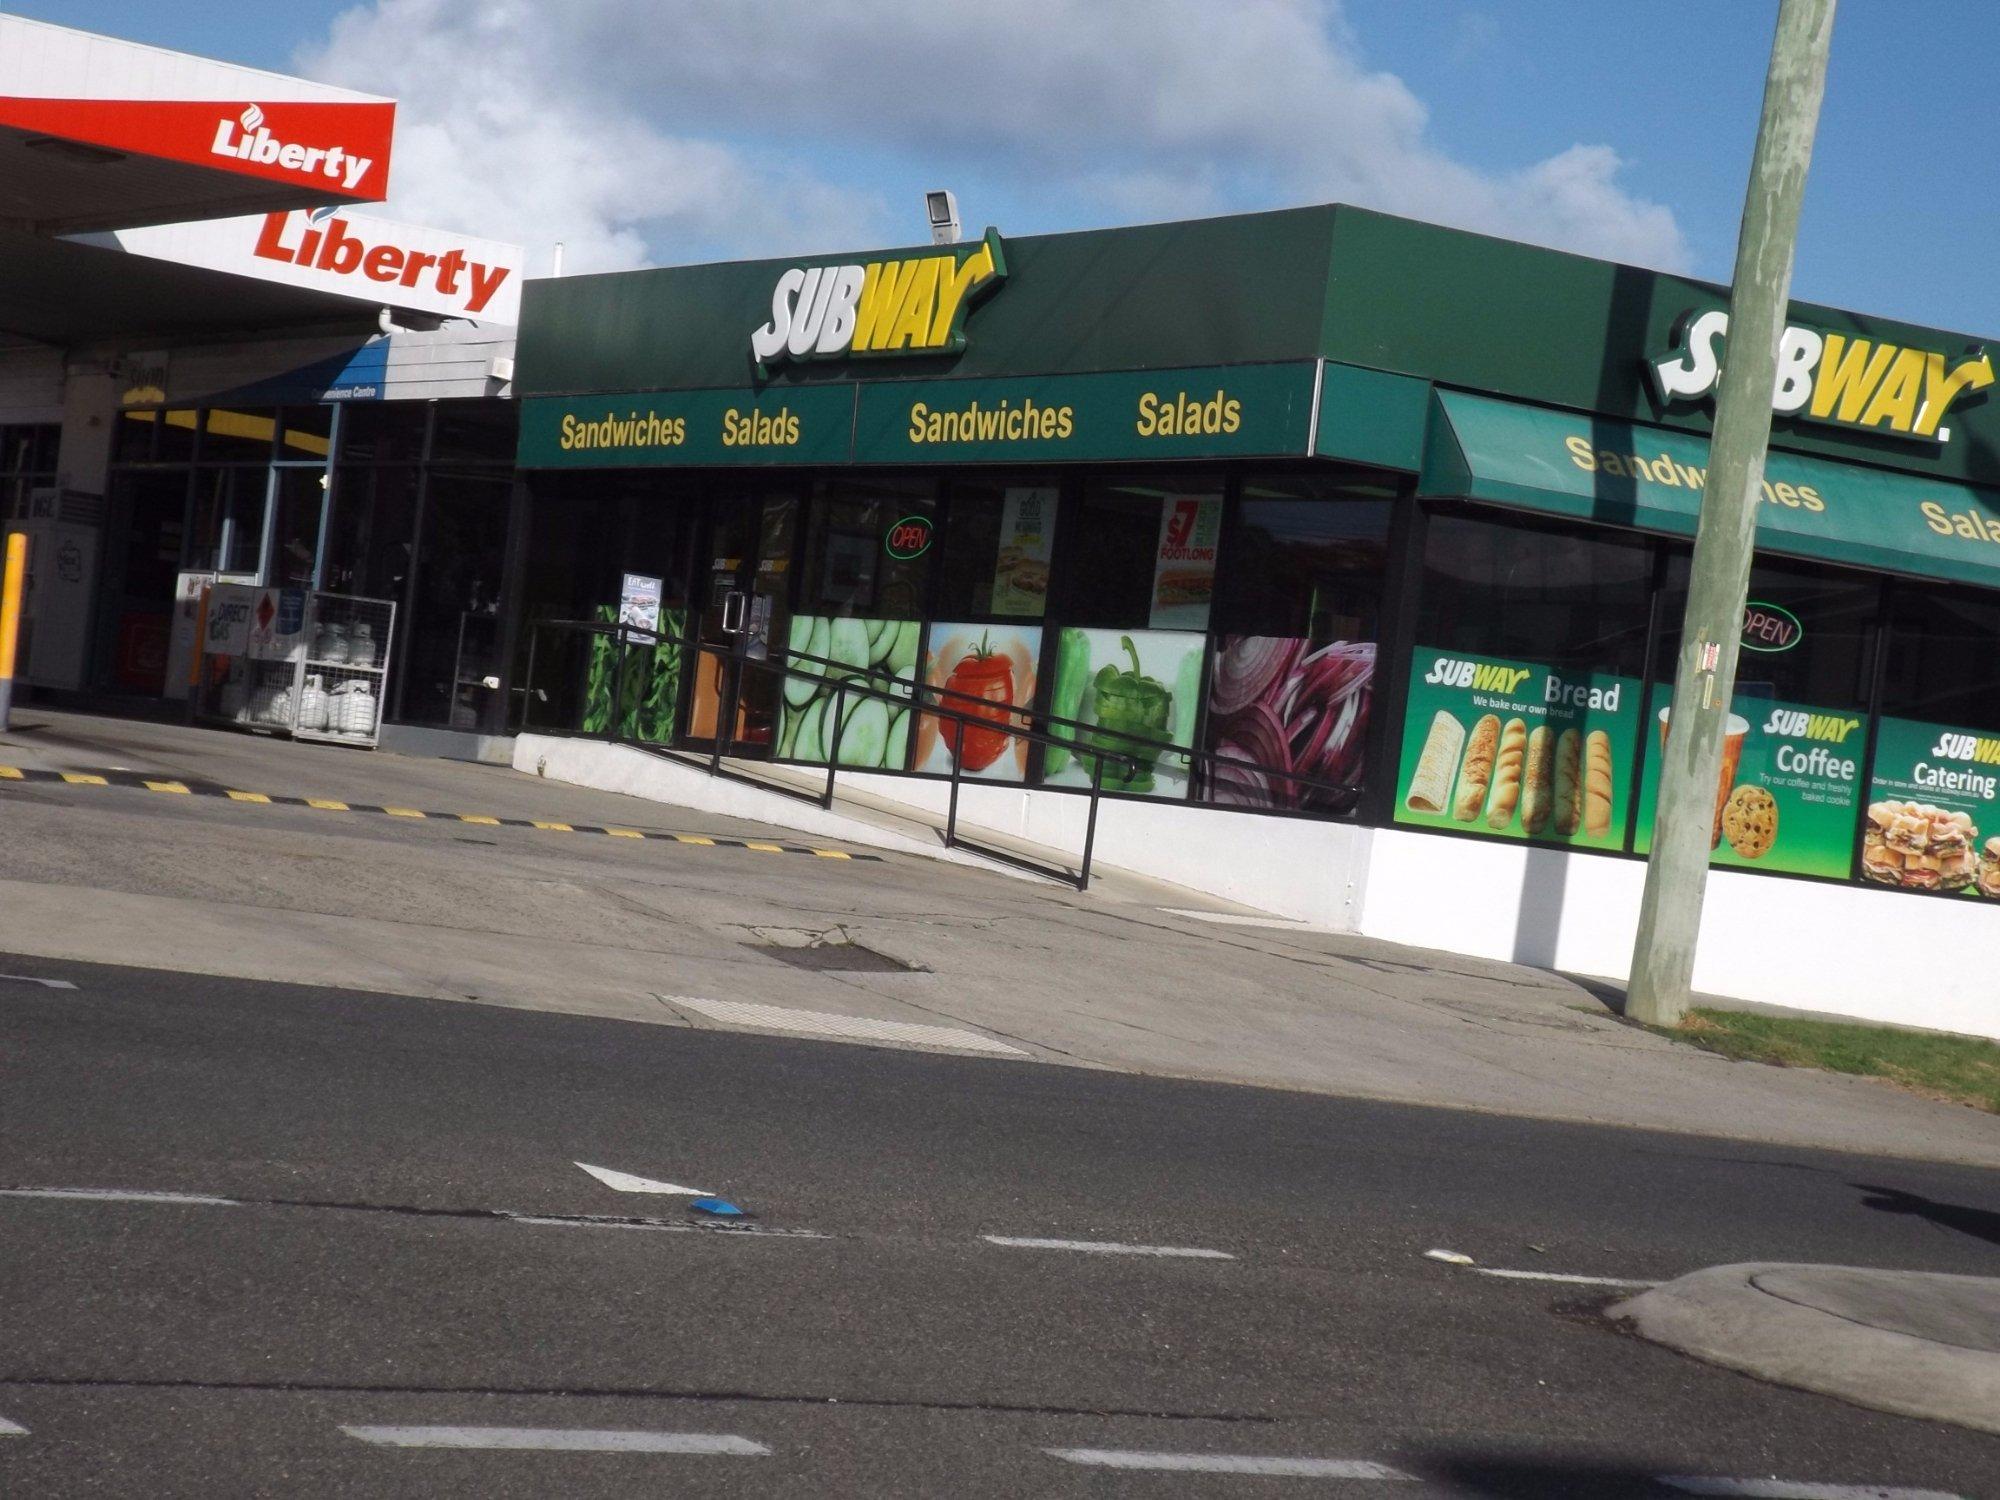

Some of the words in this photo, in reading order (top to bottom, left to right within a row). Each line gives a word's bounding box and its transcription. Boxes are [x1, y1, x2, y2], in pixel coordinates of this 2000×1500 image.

[211, 117, 372, 189] Liberty
[253, 210, 510, 313] Liberty
[751, 242, 994, 363] SUBWAY
[353, 386, 376, 398] Centre
[1657, 311, 1995, 437] SBWAY
[560, 411, 686, 450] Sandwiches
[722, 406, 800, 447] Salads
[908, 398, 1073, 444] Sandwiches
[1135, 390, 1242, 437] Salads
[1565, 437, 1825, 512] Sandwhes
[891, 525, 928, 550] OPEN
[1160, 547, 1214, 561] FOOTLONG
[1425, 658, 1530, 694] SUBWAY
[1545, 675, 1620, 712] Bread
[1473, 695, 1488, 706] We
[1489, 697, 1510, 710] bake
[1512, 703, 1526, 712] our
[1529, 705, 1547, 715] own
[1549, 706, 1574, 719] bread
[1762, 709, 1859, 743] SUBWAY
[1777, 745, 1855, 780] Coffee
[1914, 762, 1996, 799] Catering
[1760, 772, 1771, 785] Try
[1773, 777, 1786, 785] our
[1787, 777, 1810, 788] coffee
[1812, 781, 1826, 790] and
[1827, 782, 1852, 796] freshly
[1801, 792, 1825, 803] baked
